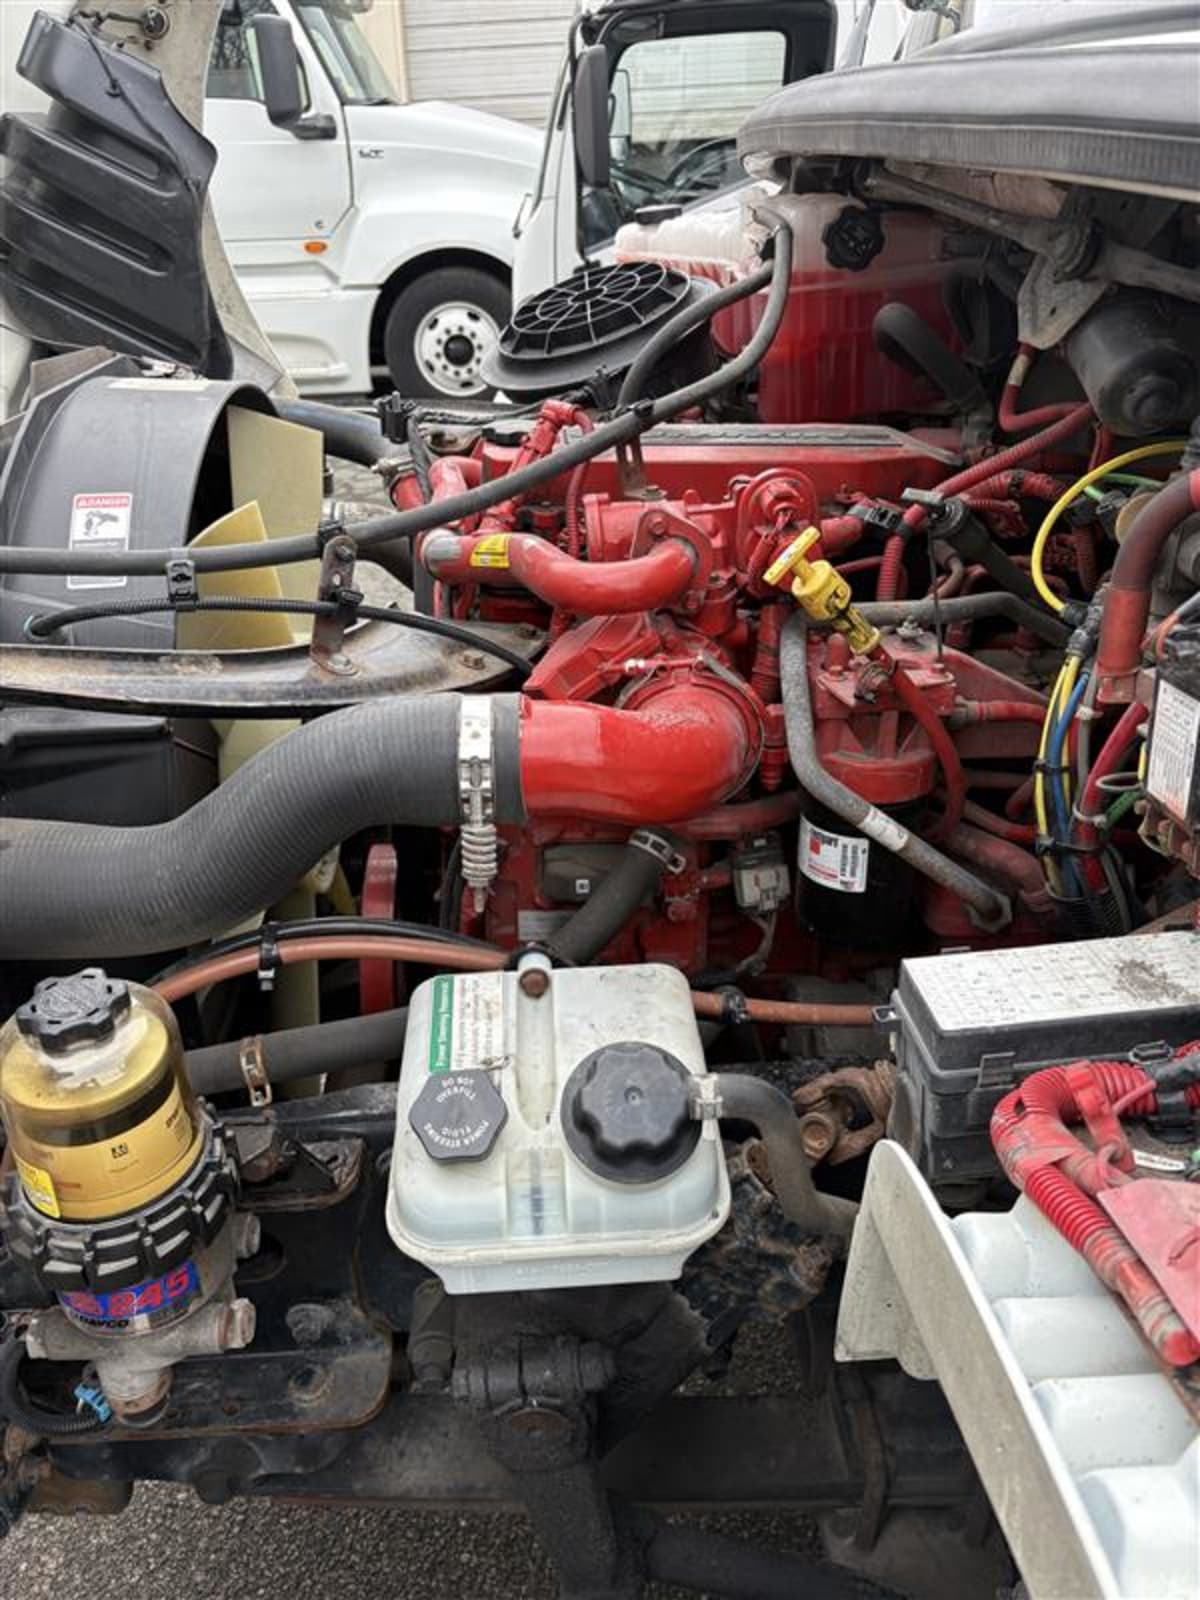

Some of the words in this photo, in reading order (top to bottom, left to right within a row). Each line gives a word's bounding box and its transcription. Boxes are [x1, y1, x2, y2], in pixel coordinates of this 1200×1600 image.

[441, 1077, 455, 1088] DO
[457, 1077, 475, 1088] NOT
[435, 1085, 477, 1103] OVERFILL
